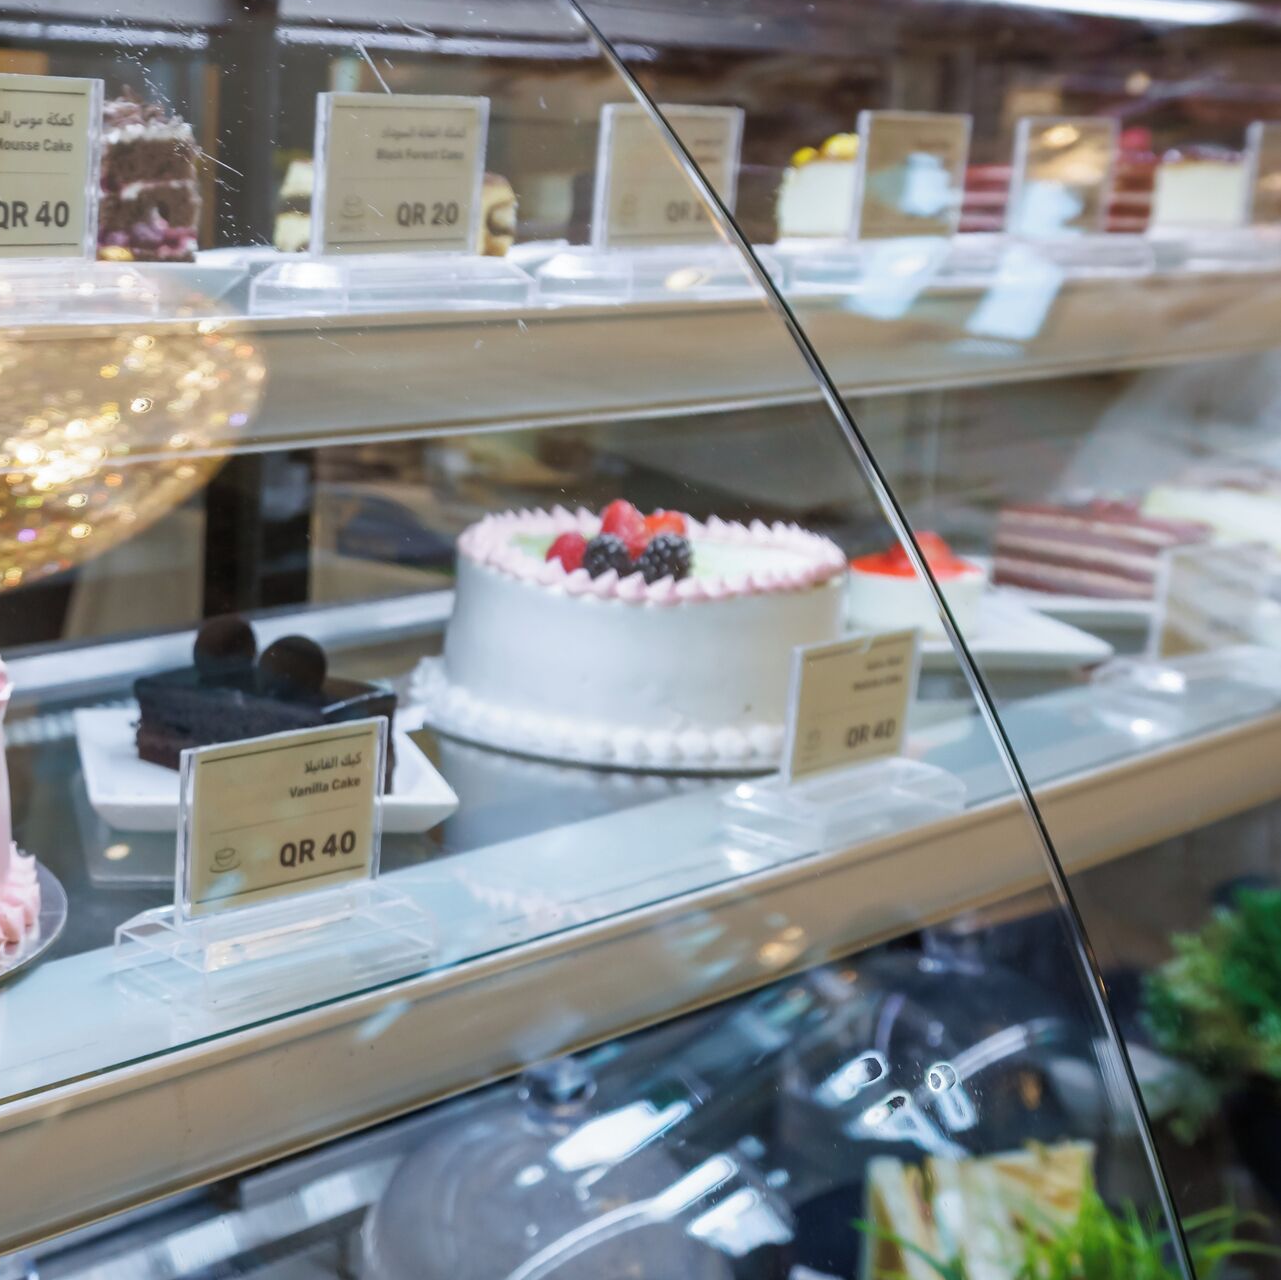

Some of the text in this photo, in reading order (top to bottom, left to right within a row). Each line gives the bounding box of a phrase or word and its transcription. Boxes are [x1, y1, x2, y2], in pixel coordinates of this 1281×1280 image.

[42, 139, 73, 152] Cake
[35, 201, 70, 228] 40
[396, 202, 460, 227] QR 20
[289, 776, 361, 799] Vanilla Cake
[279, 830, 358, 868] QR 40
